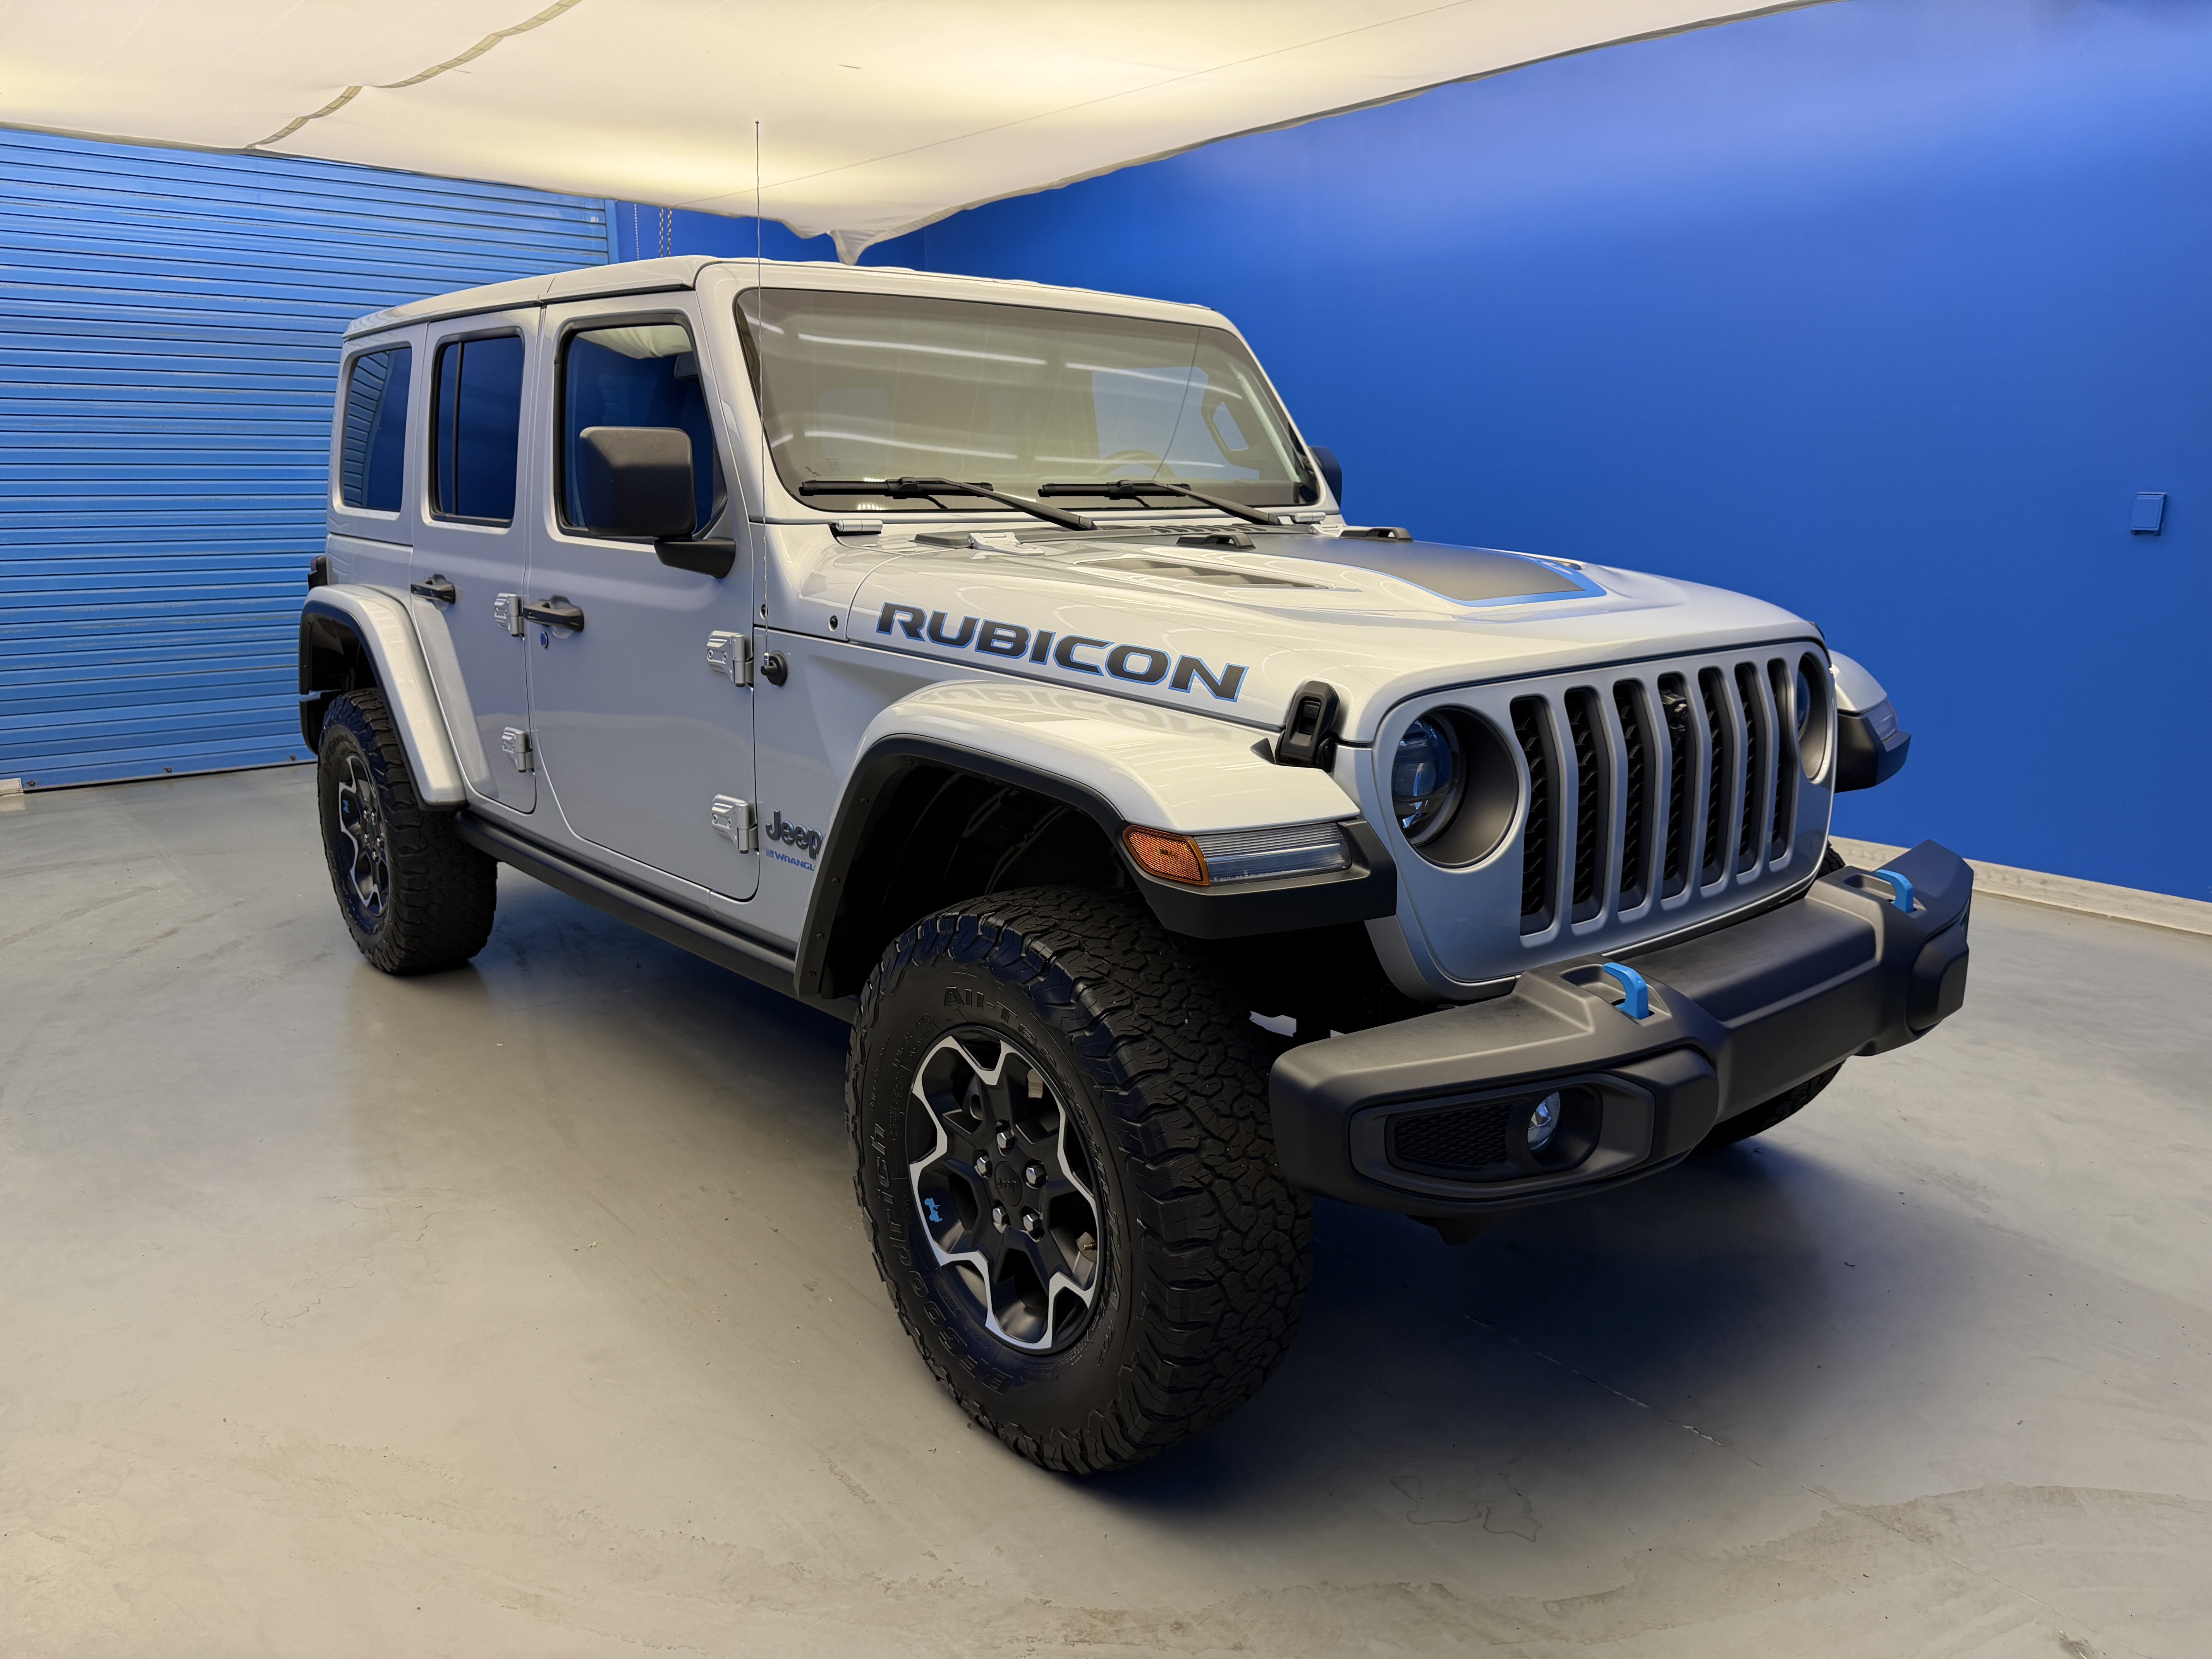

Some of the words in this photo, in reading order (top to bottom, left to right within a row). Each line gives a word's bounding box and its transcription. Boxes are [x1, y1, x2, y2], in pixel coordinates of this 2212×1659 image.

[876, 601, 1250, 703] RUBICON
[765, 809, 824, 859] Jeep
[775, 851, 815, 871] WRANGL
[870, 1123, 1013, 1396] BFGoodrich
